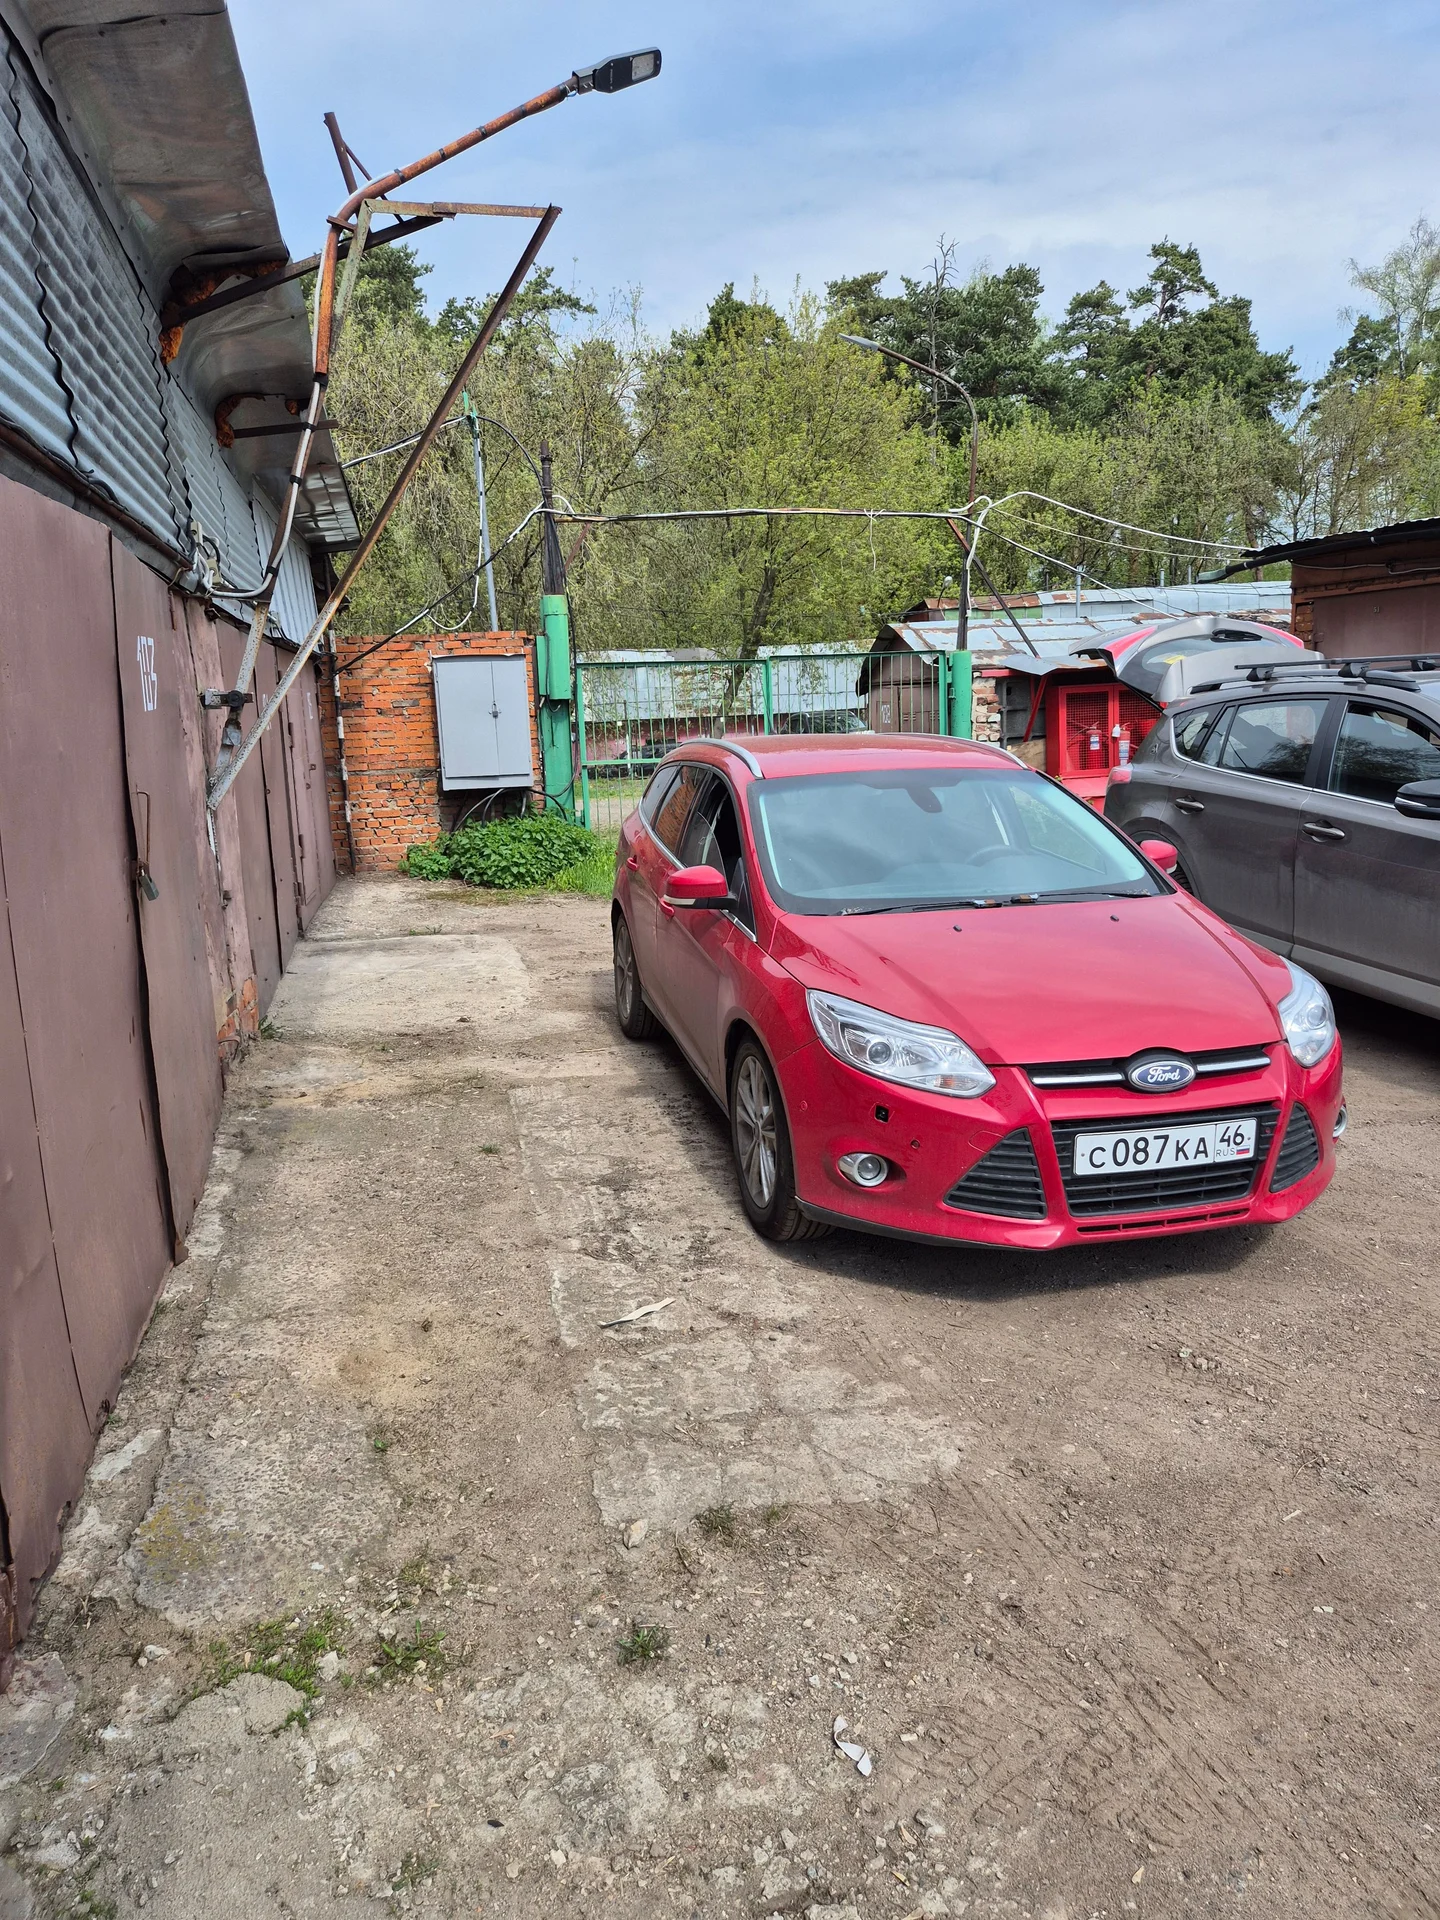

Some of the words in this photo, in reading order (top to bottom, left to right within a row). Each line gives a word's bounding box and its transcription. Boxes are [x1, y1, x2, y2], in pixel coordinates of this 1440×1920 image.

[137, 635, 158, 712] 103
[1147, 1065, 1181, 1083] Ford
[1219, 1124, 1245, 1147] 46
[1215, 1148, 1236, 1158] RUS
